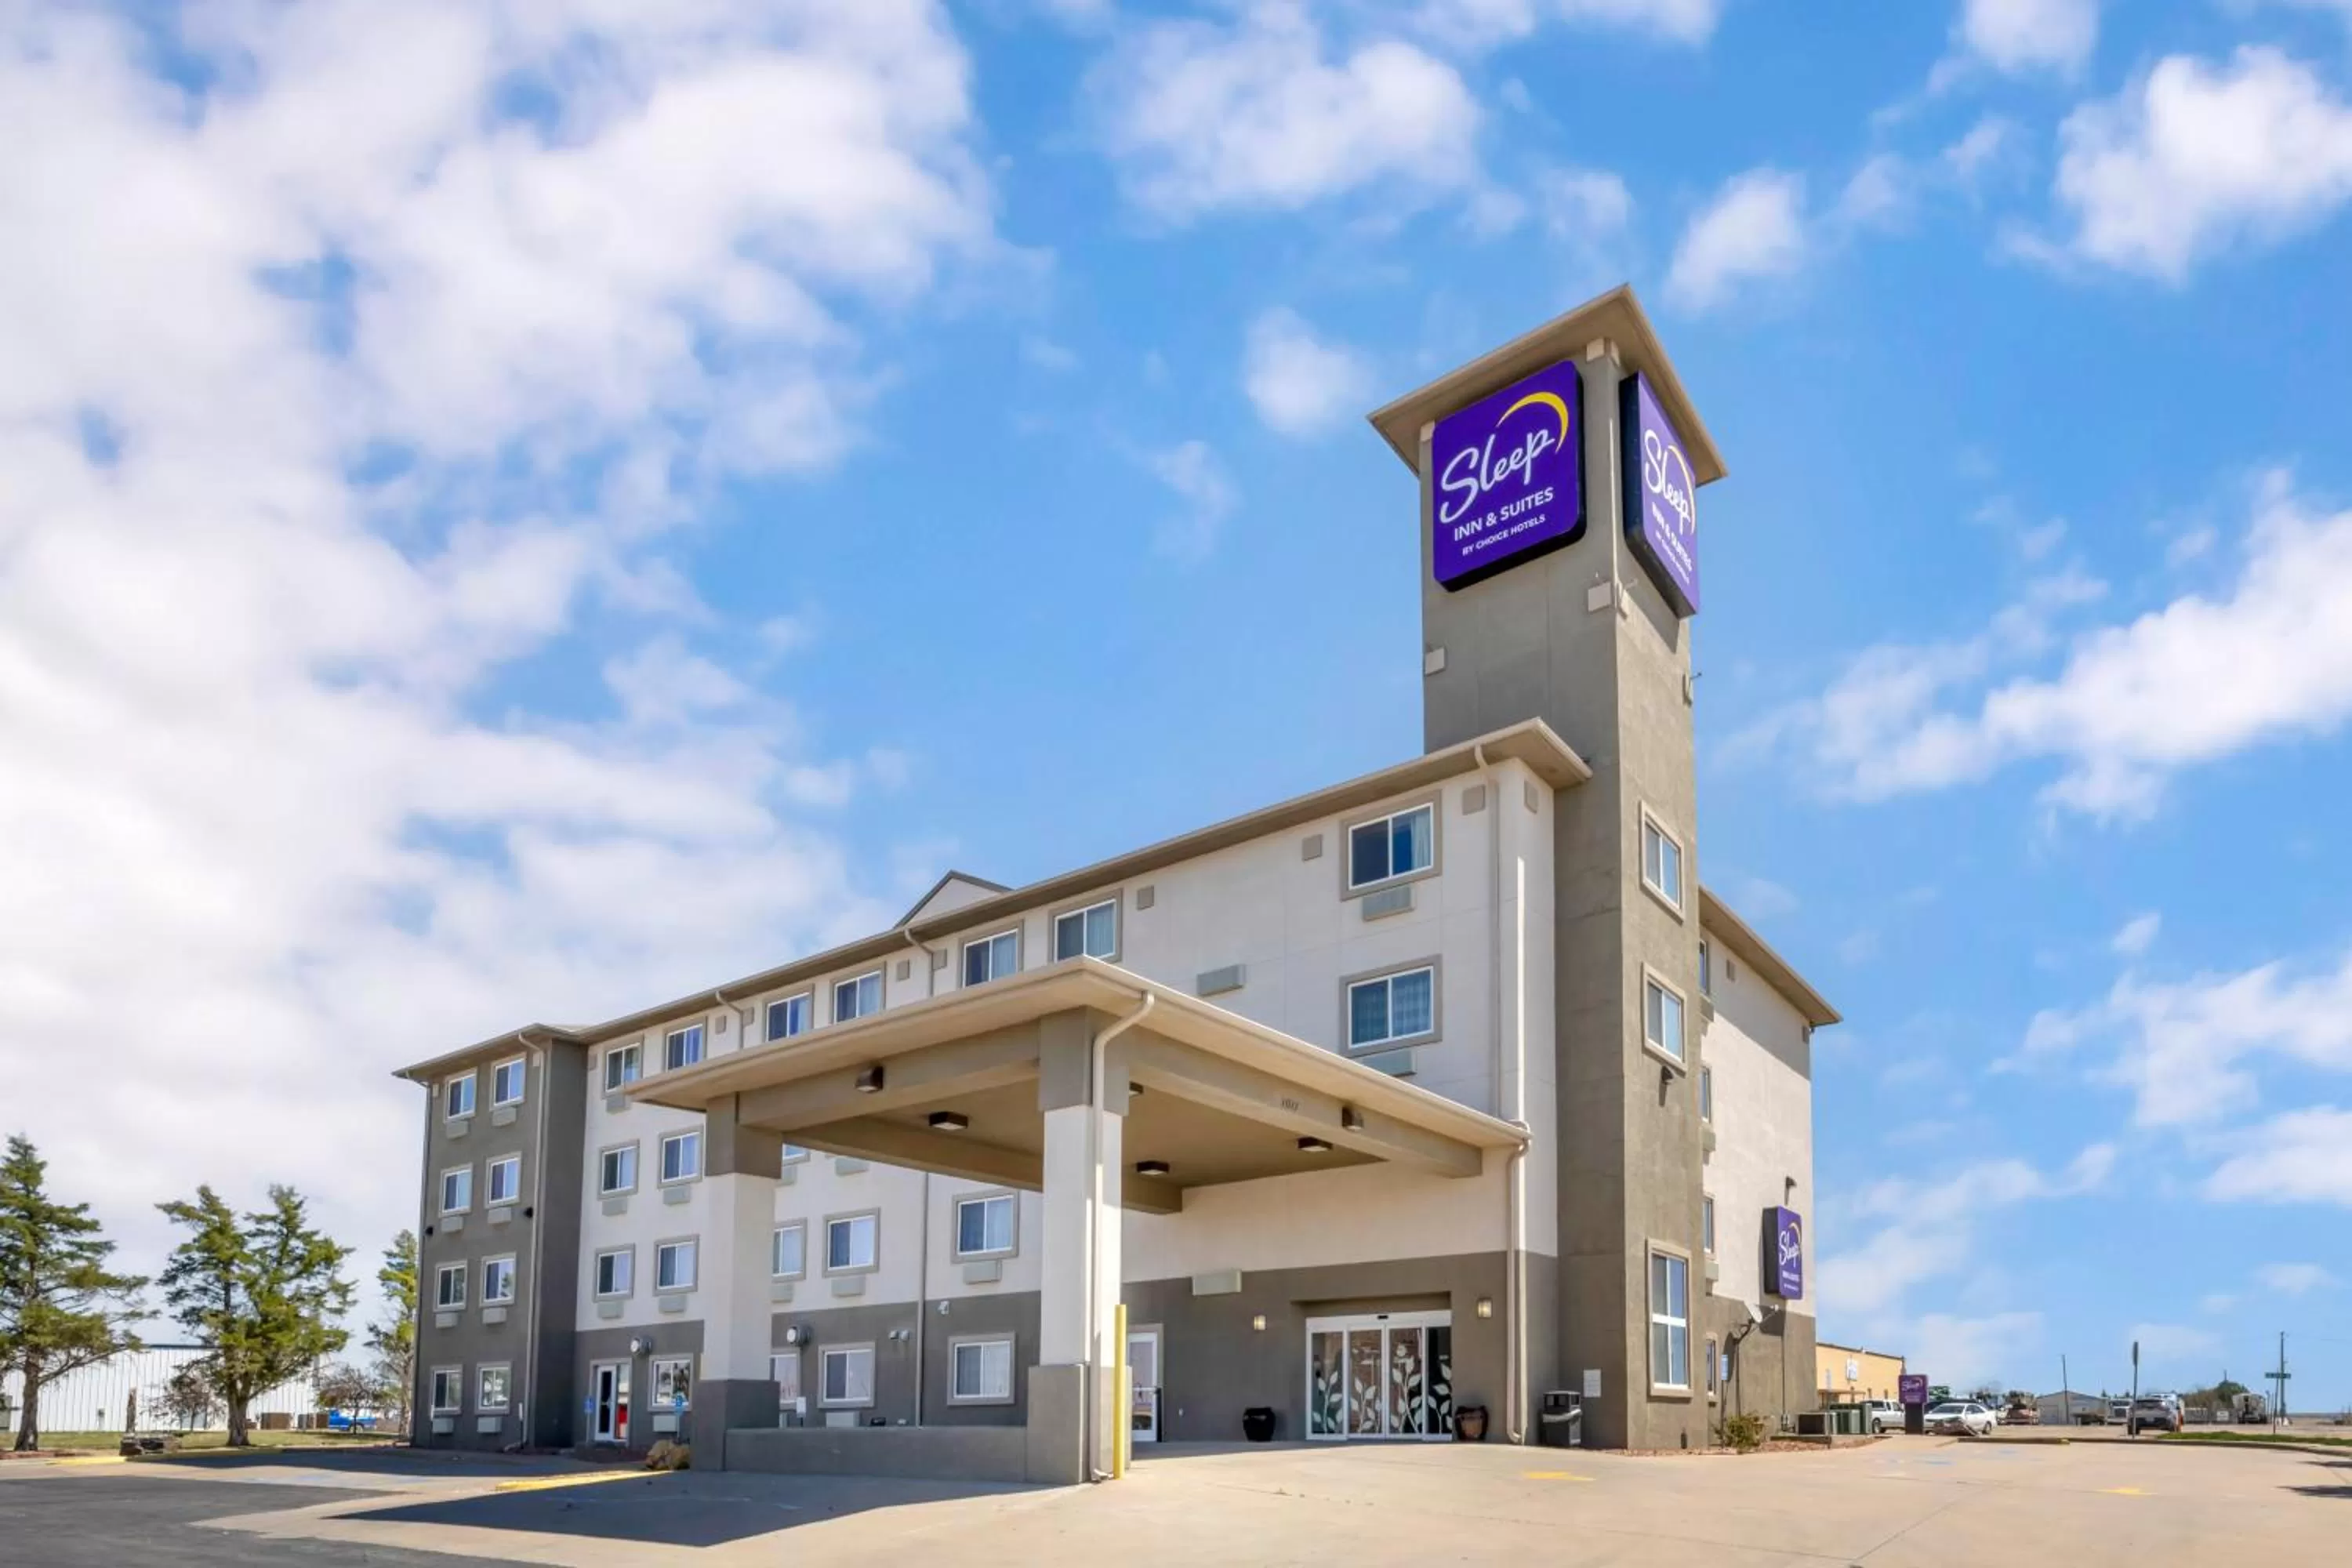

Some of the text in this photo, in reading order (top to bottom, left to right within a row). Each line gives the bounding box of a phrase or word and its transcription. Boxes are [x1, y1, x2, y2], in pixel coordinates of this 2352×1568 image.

[1439, 429, 1555, 523] Sleep
[1644, 429, 1691, 535] Sleep
[1454, 487, 1554, 542] INN & SUITES
[1462, 514, 1546, 557] BY CHOICE HOTELS
